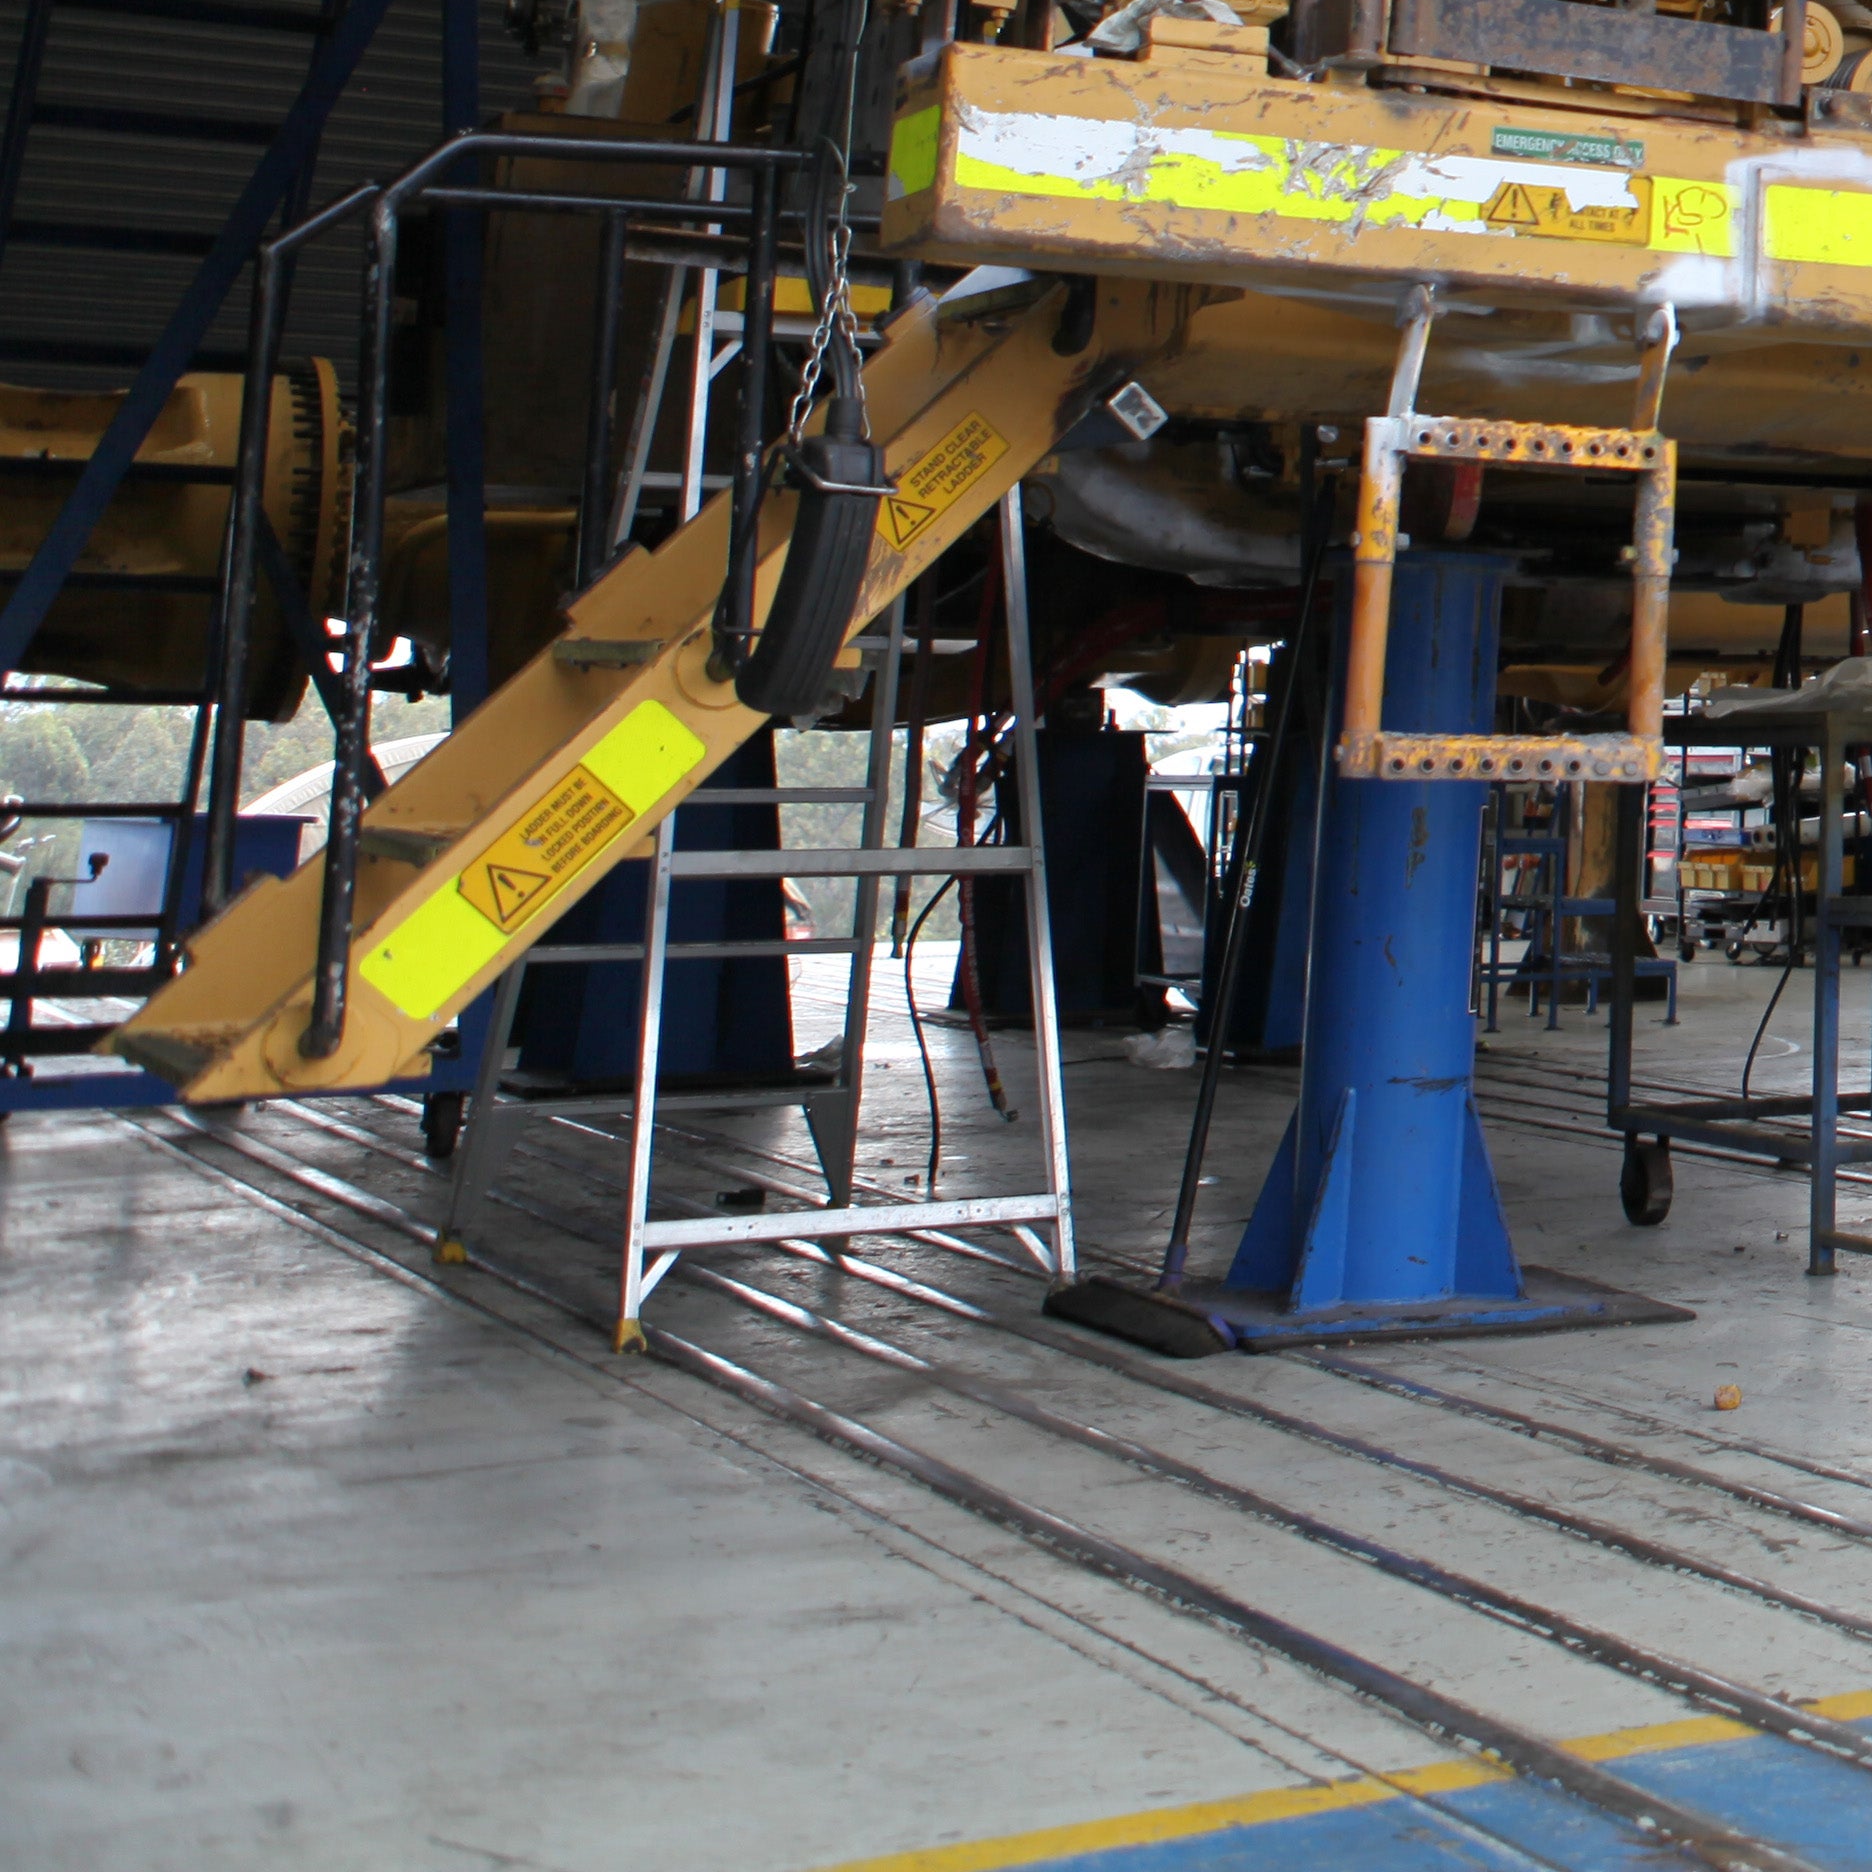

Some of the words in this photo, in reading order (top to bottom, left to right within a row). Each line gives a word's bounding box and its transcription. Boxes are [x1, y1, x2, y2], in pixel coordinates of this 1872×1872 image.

[1569, 219, 1586, 231] ALL
[1588, 220, 1617, 232] TIMES
[910, 452, 946, 488] STAND
[944, 420, 981, 455] CLEAR
[918, 429, 992, 499] RETRACTABLE
[943, 452, 988, 495] LADDER
[519, 809, 552, 840] LADDER
[551, 787, 576, 812] MUST
[573, 777, 587, 791] BE
[541, 831, 574, 862] LOCKED
[573, 798, 611, 834] POSITION
[545, 817, 571, 838] FULL
[566, 793, 593, 818] DOWN
[551, 844, 584, 874] BEFORE
[580, 807, 624, 846] BOARDING
[1240, 869, 1258, 908] Oates
